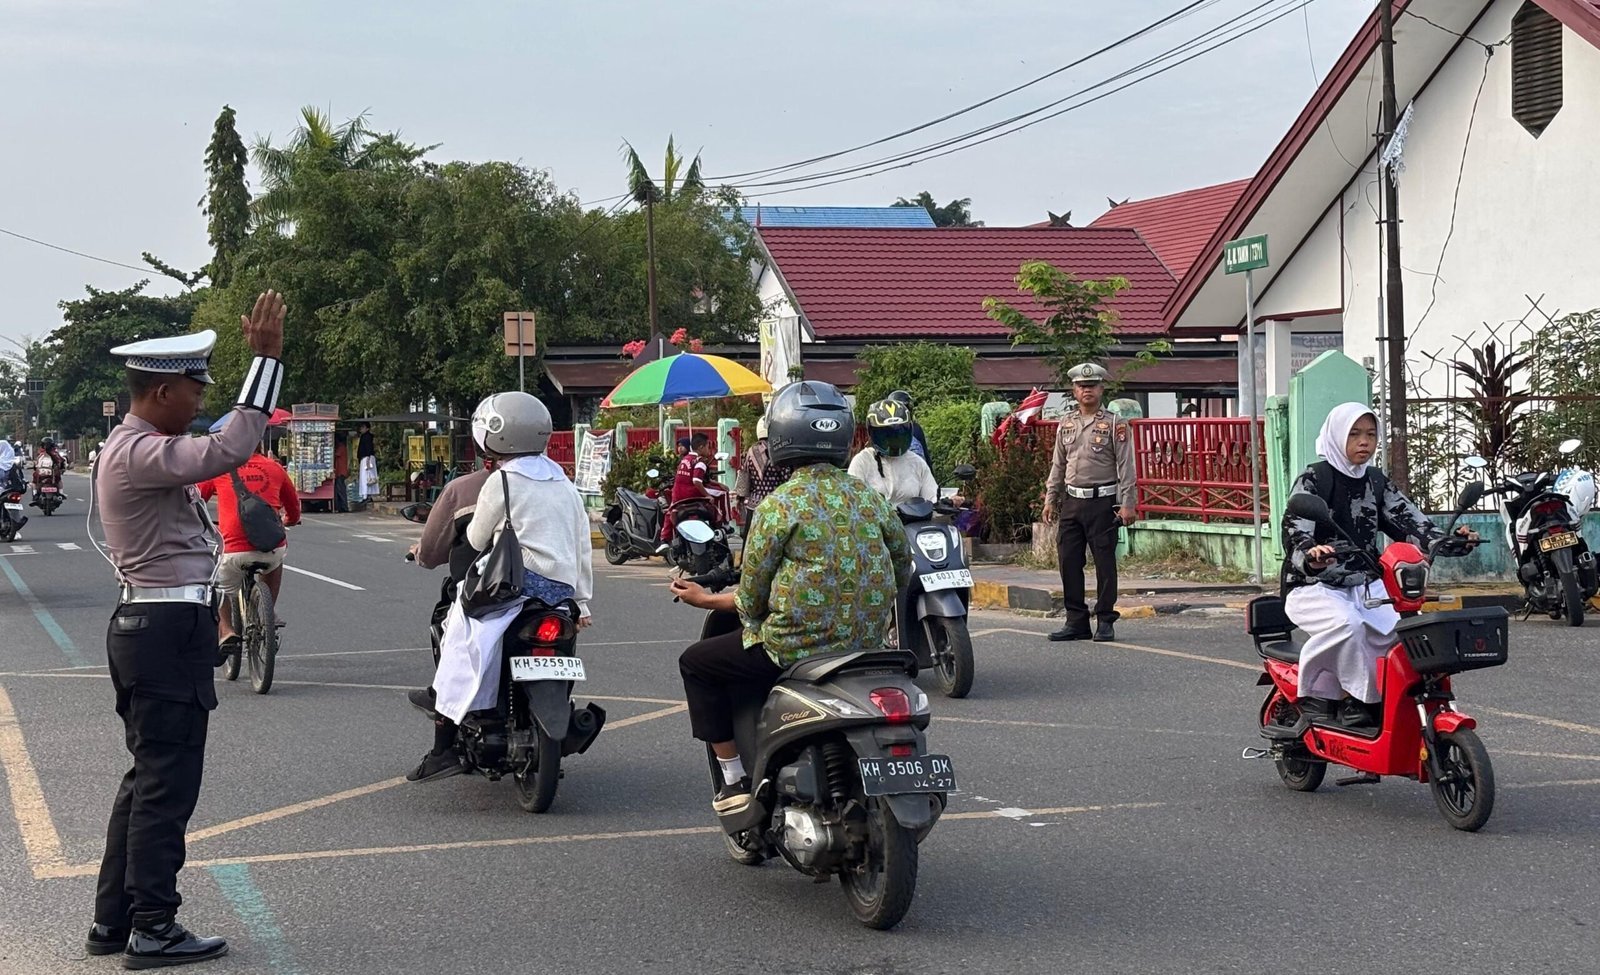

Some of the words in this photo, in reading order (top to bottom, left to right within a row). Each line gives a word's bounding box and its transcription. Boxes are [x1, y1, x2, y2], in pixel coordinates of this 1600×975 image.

[514, 659, 530, 668] KH
[533, 658, 564, 668] 5259
[567, 659, 581, 669] DH
[780, 710, 811, 722] Genio
[862, 762, 881, 777] KH
[887, 761, 923, 776] 3506
[931, 759, 951, 774] DK
